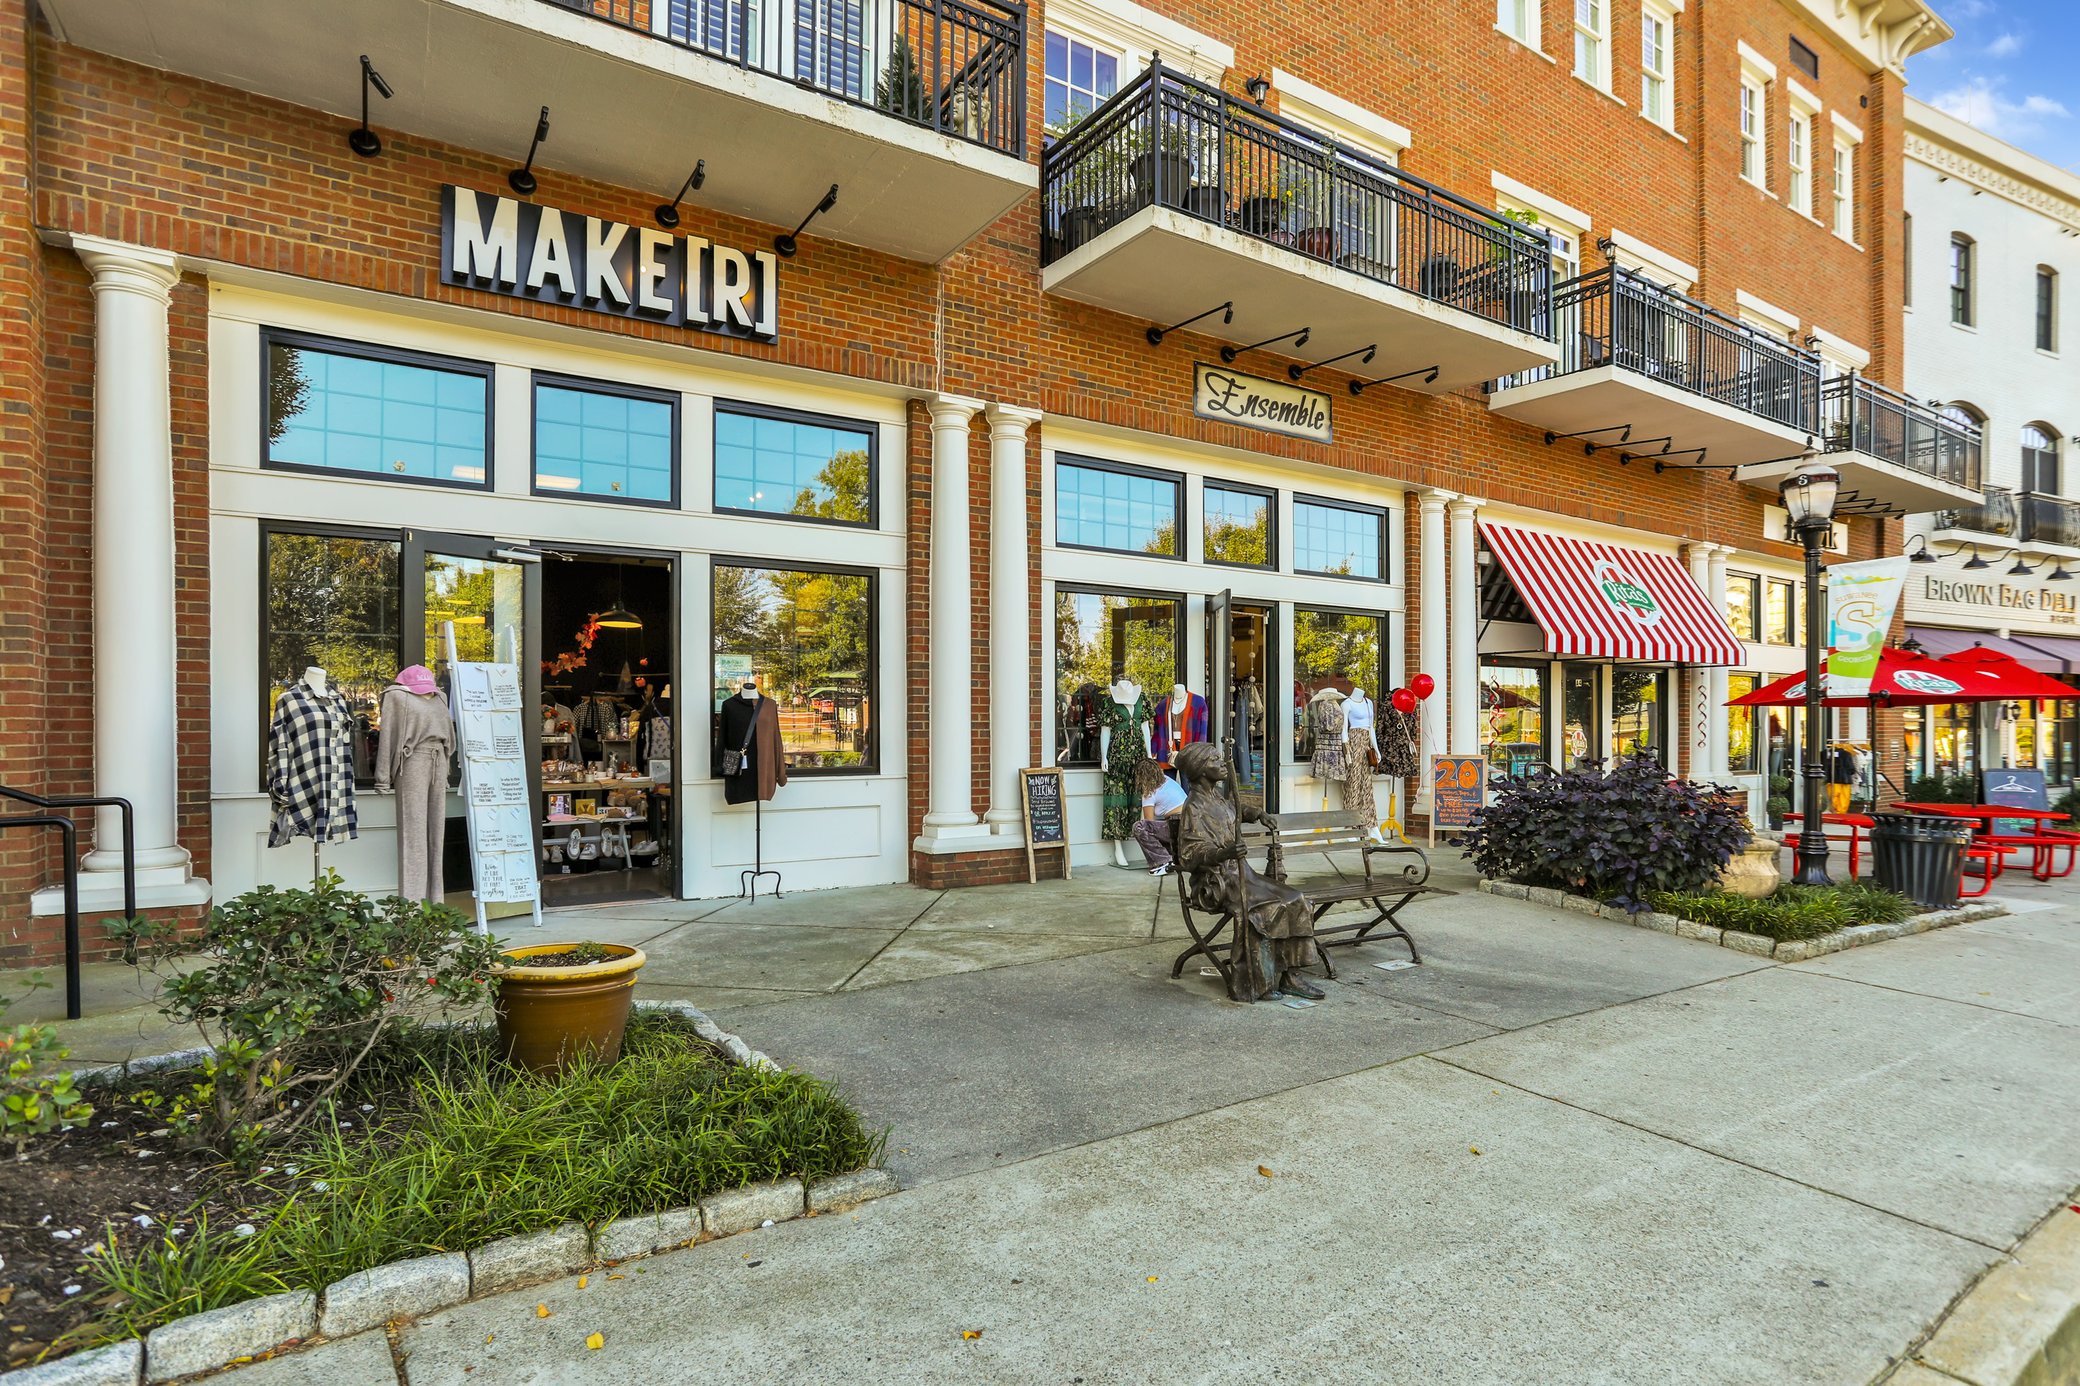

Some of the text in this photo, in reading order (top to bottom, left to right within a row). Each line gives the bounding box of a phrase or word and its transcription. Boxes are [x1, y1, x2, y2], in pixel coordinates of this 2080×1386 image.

[453, 185, 777, 337] MAKE[R]
[1204, 371, 1325, 430] Ensemble
[1603, 579, 1649, 604] Rita's
[1925, 575, 2076, 613] BROWN BAG DELI
[1032, 785, 1057, 796] HIRING
[1035, 776, 1050, 785] NOW
